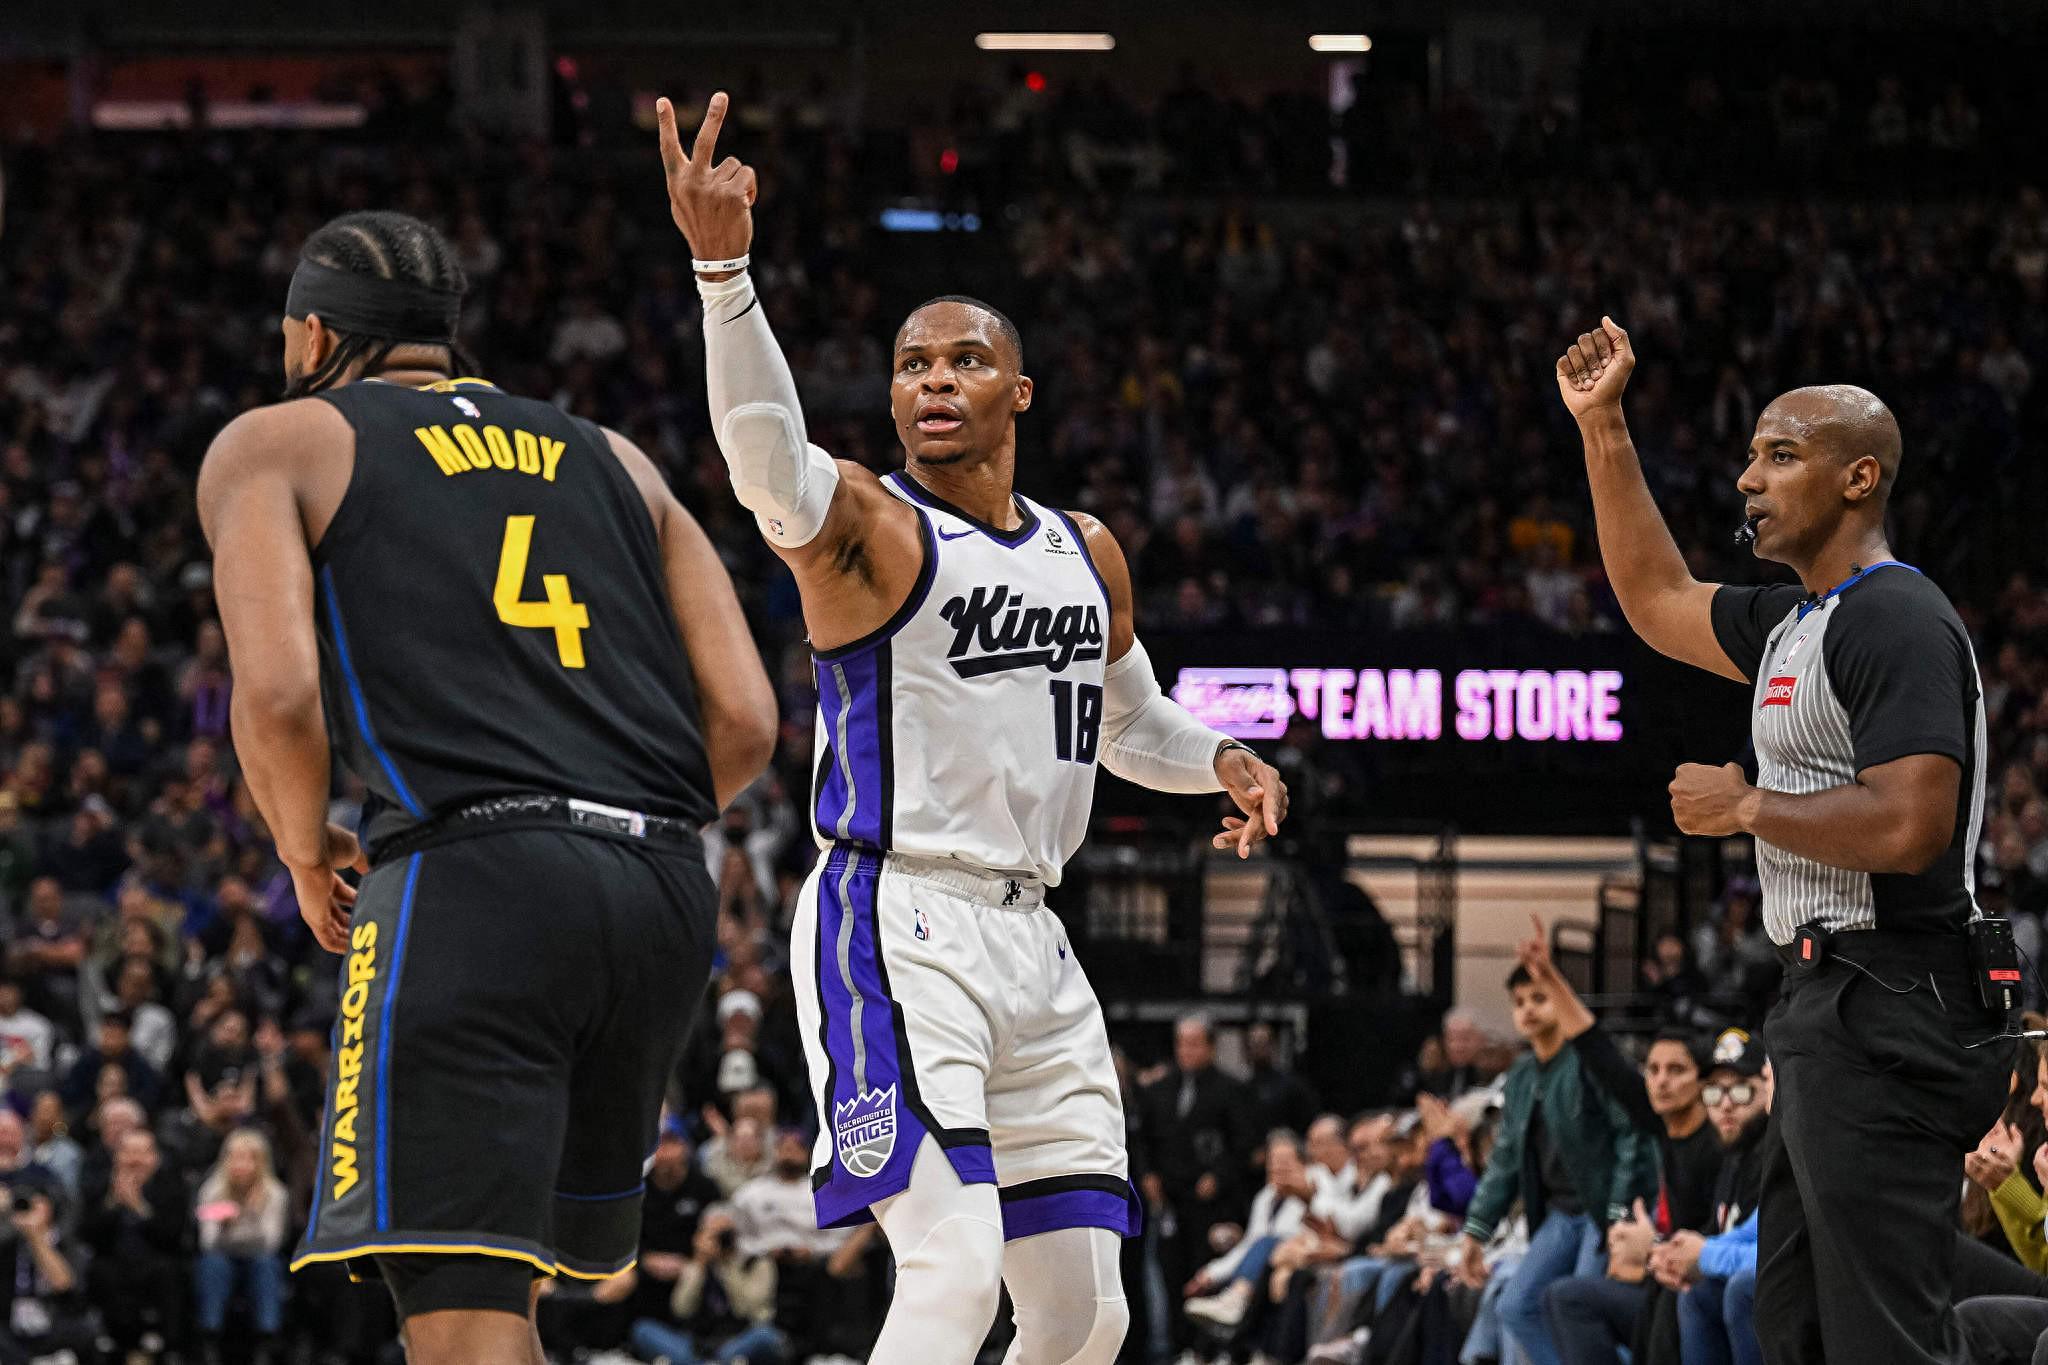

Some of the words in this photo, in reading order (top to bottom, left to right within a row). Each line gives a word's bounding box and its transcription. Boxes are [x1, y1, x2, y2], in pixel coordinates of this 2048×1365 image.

[414, 424, 566, 482] MOODY
[493, 515, 590, 668] 4
[938, 584, 1102, 674] Kings
[1049, 679, 1103, 766] 18
[1289, 668, 1443, 741] TEAM
[1454, 668, 1624, 742] STORE
[333, 920, 378, 1201] WARRIORS
[838, 1107, 891, 1132] SACRAMENTO
[839, 1117, 894, 1152] KINGS
